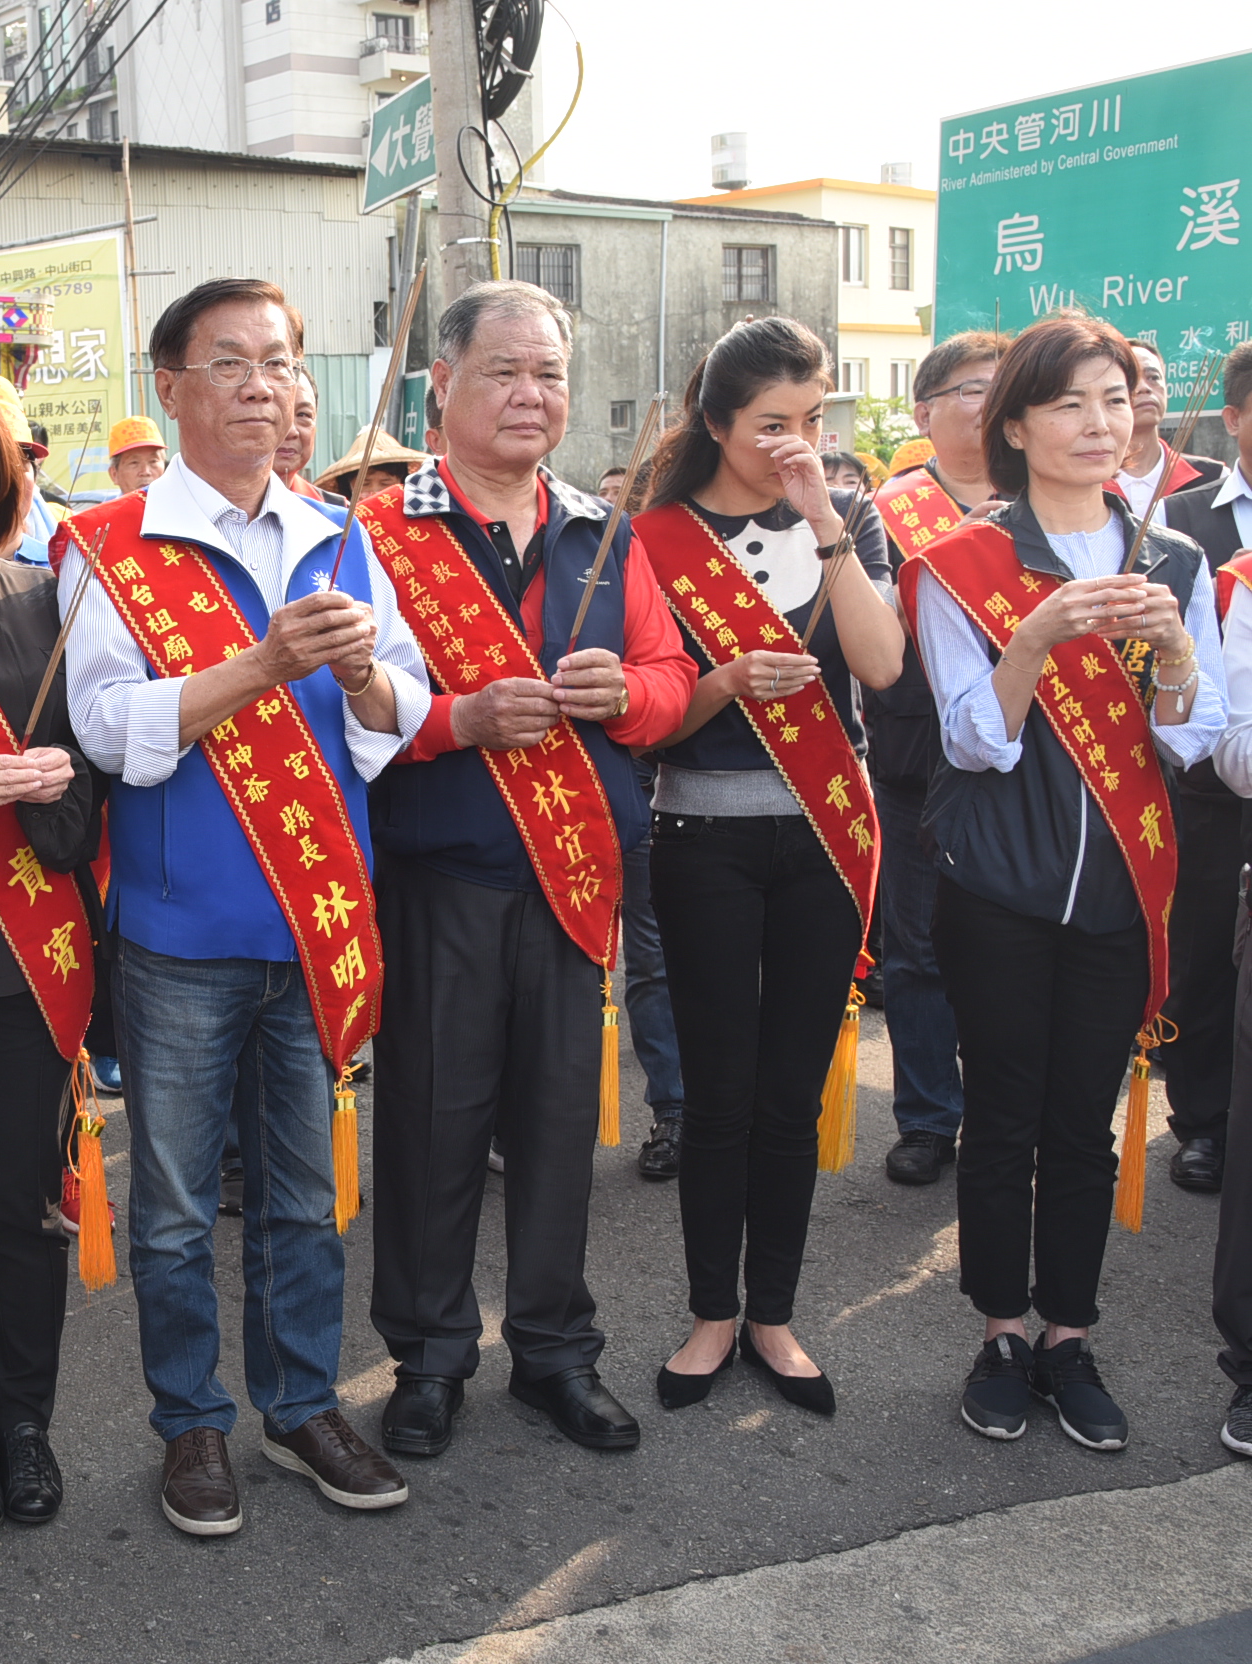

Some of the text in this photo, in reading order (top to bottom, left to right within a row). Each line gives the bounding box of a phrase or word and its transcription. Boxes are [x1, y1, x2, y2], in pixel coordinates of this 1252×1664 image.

[941, 134, 1179, 193] River Administered by Central Government
[949, 94, 1121, 165] 中央管河川
[1029, 274, 1189, 316] Wu River
[1164, 360, 1210, 379] RCES
[377, 492, 508, 667] 草屯敦和宮
[278, 798, 328, 871] 縣長
[530, 769, 604, 912] 林宜裕
[825, 773, 875, 857] 貴賓
[7, 844, 80, 985] 貴賓
